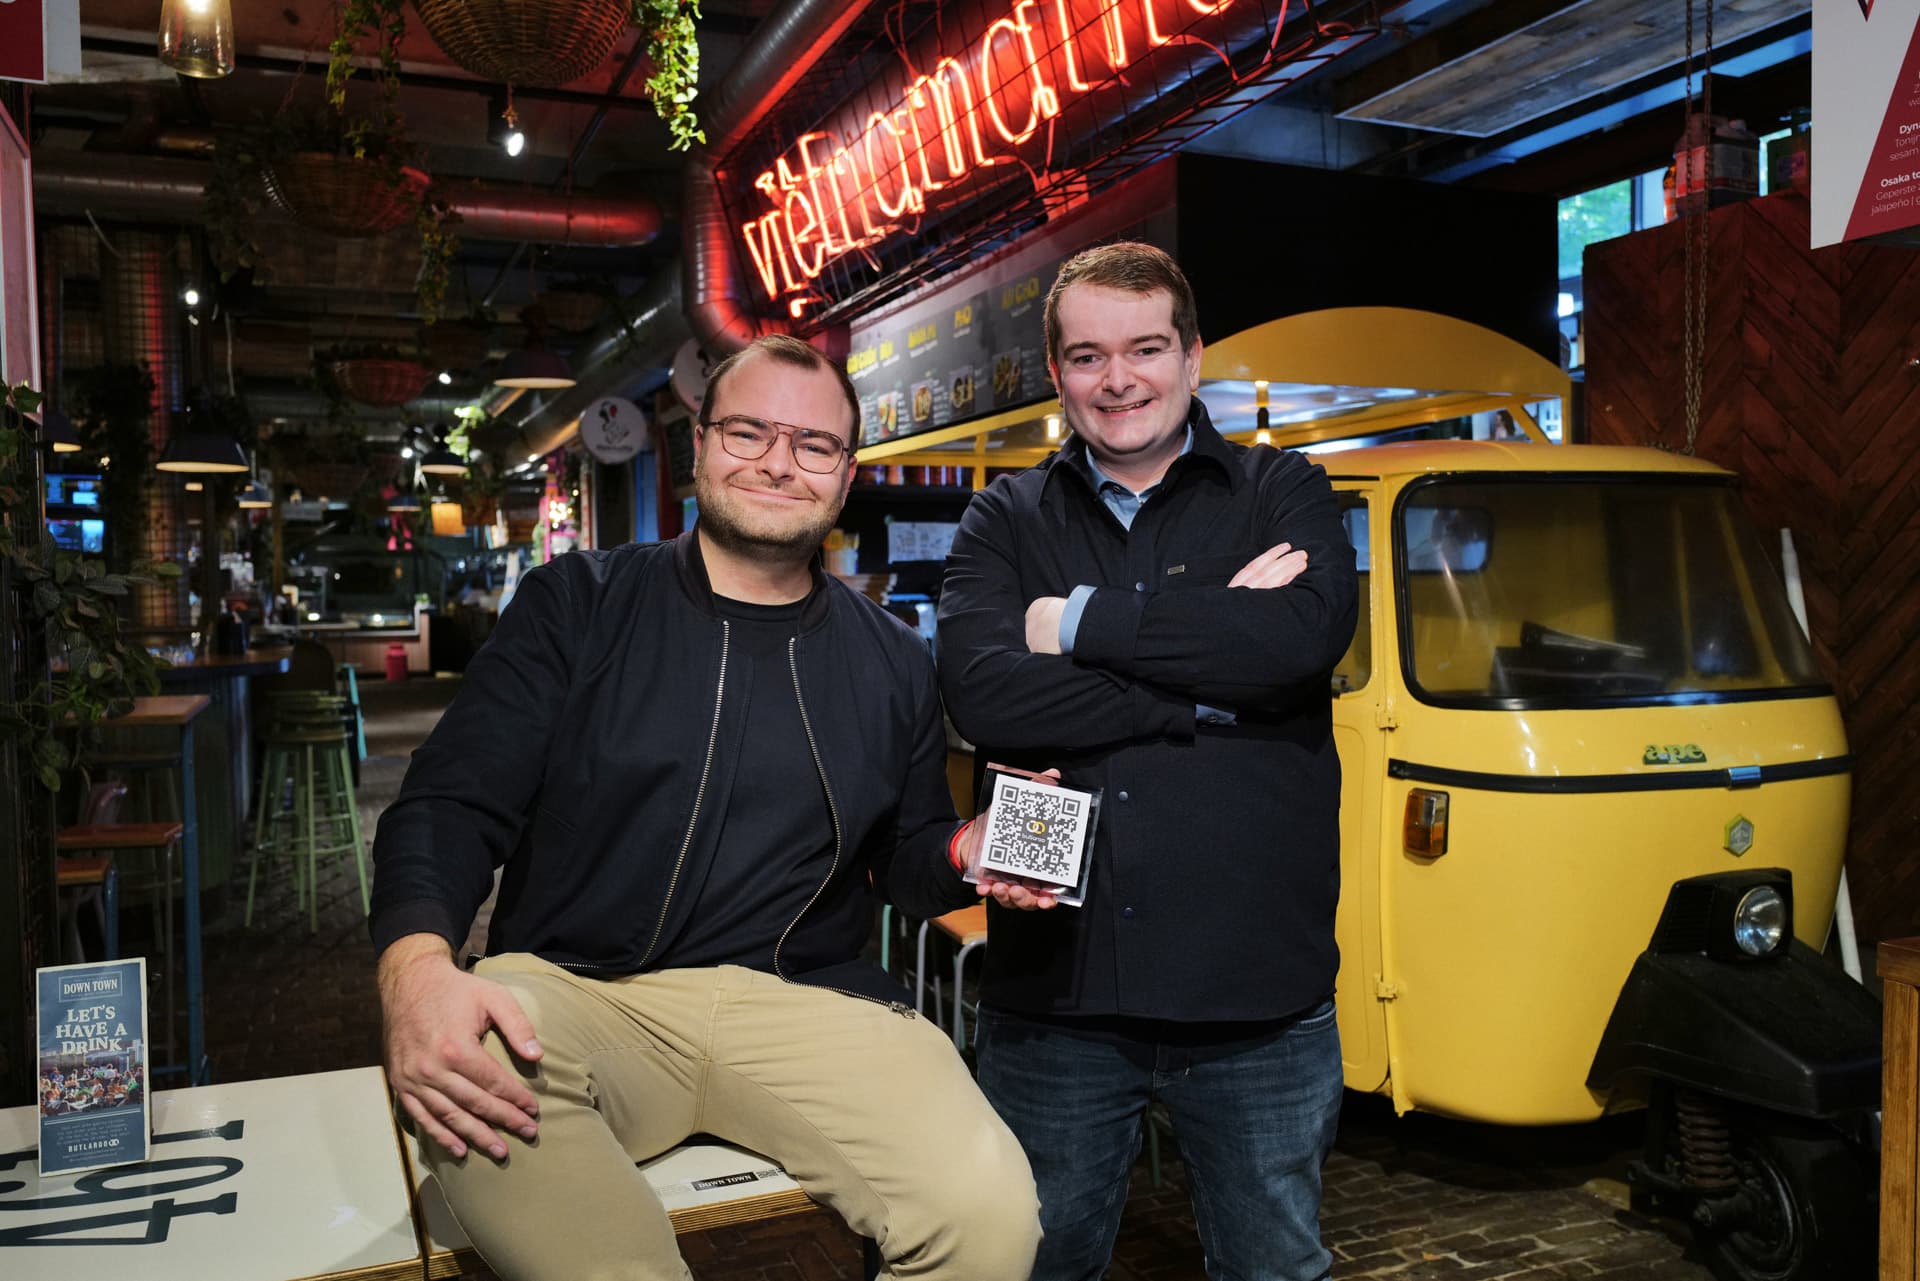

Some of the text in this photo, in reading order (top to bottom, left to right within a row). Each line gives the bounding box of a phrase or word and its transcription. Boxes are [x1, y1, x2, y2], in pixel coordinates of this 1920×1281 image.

[1880, 174, 1910, 188] Osaka
[1875, 185, 1917, 201] Geperste
[1645, 743, 1704, 764] ape
[63, 978, 118, 995] DOWN TOWN
[67, 1004, 116, 1023] LET'S
[56, 1022, 128, 1039] HAVE A
[61, 1036, 122, 1055] DRINK
[698, 1178, 726, 1189] DOWN
[727, 1174, 752, 1184] TOWN
